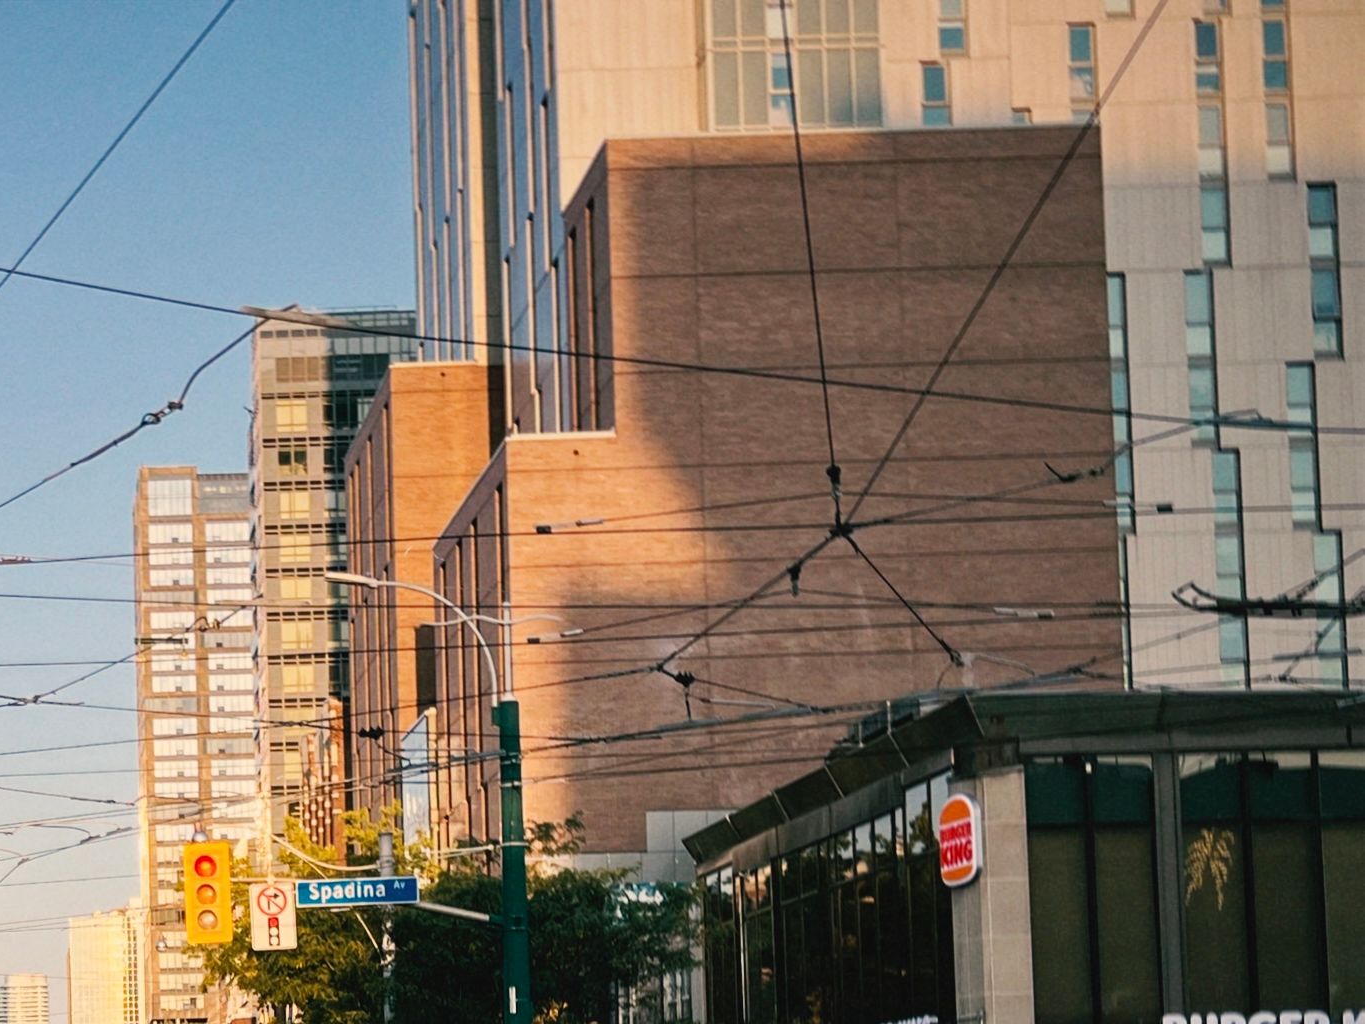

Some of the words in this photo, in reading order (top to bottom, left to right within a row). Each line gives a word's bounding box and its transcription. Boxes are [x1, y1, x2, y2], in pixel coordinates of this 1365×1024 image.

[940, 821, 972, 845] BURGER
[941, 839, 973, 868] KING
[309, 882, 386, 904] Spadina
[394, 880, 406, 889] Av
